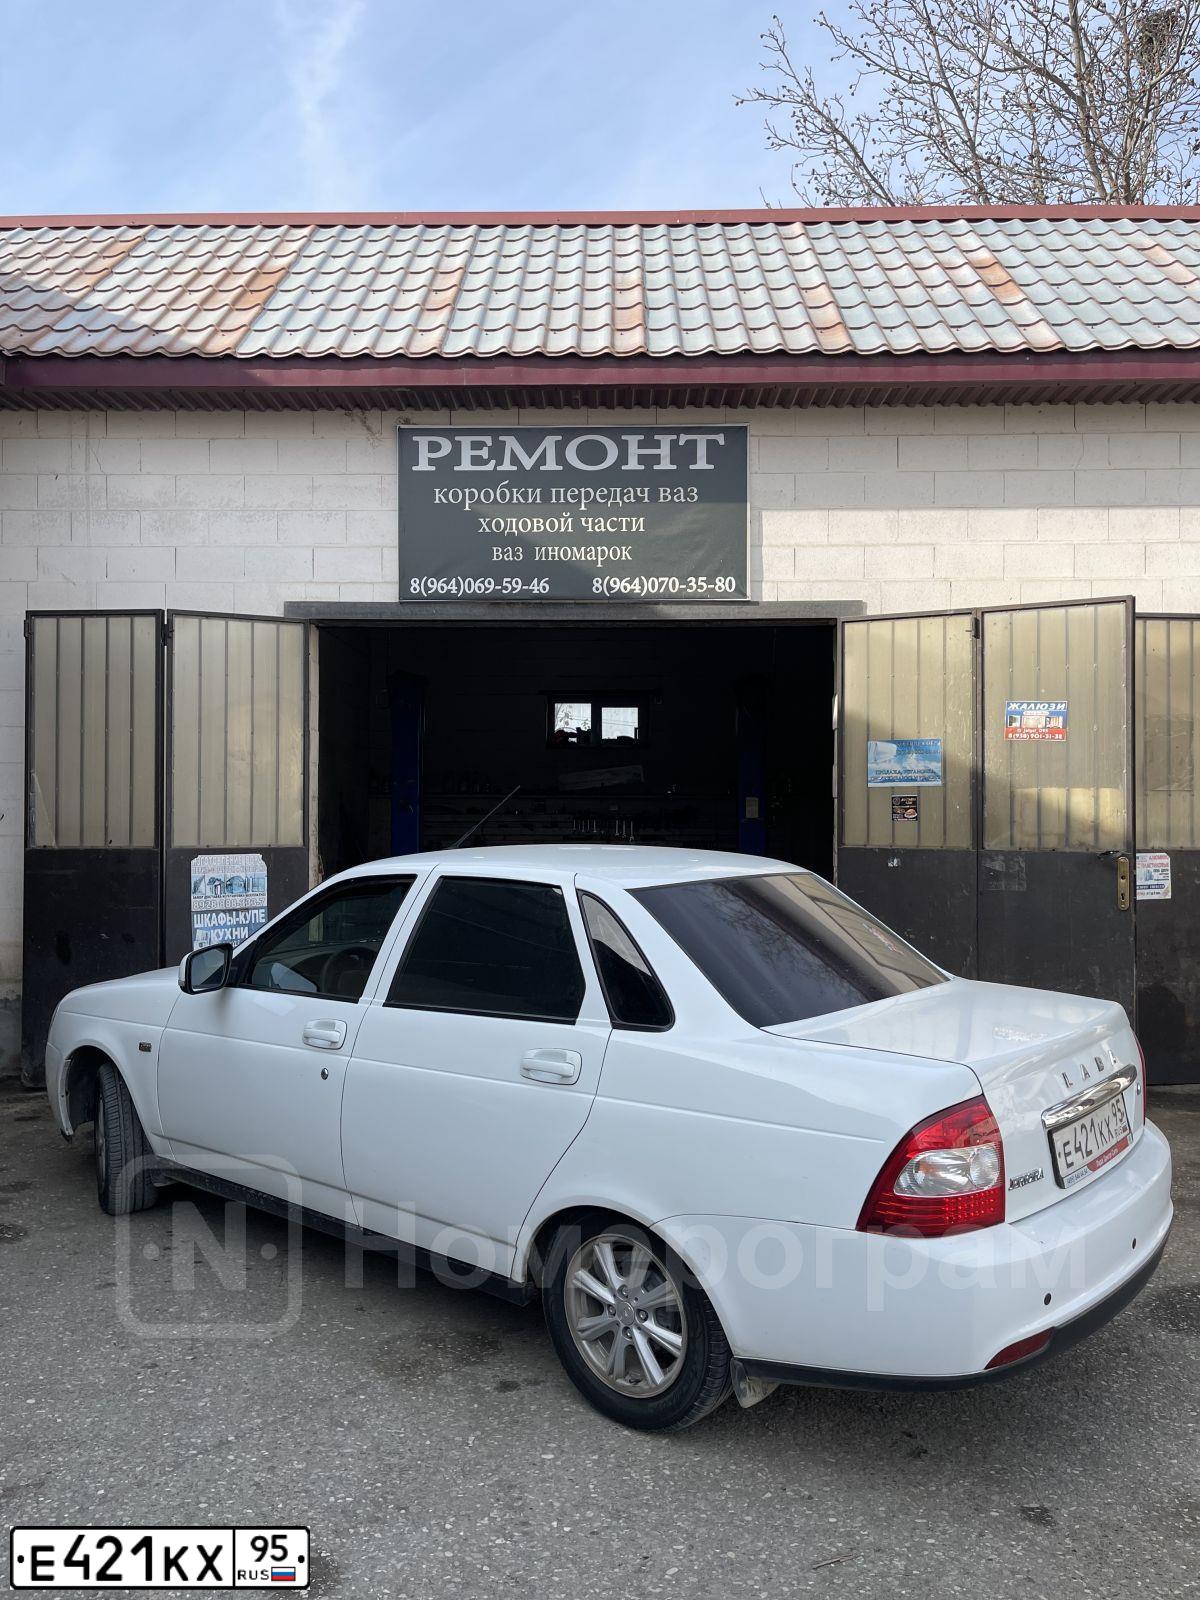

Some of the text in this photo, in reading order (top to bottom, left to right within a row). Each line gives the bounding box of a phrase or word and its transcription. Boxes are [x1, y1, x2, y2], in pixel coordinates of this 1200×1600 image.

[412, 433, 725, 471] РЕМОНТ
[433, 480, 699, 511] коробки передач ваз
[478, 512, 645, 536] ходовой части
[492, 545, 633, 568] ваз иномарок
[409, 575, 736, 596] 8(964)069-59-46 8(964)070-35-80
[1007, 702, 1066, 711] ЖАЛЮЗИ
[193, 909, 266, 928] ШКАФЫ-КУПЕ
[210, 926, 249, 940] КУХНИ
